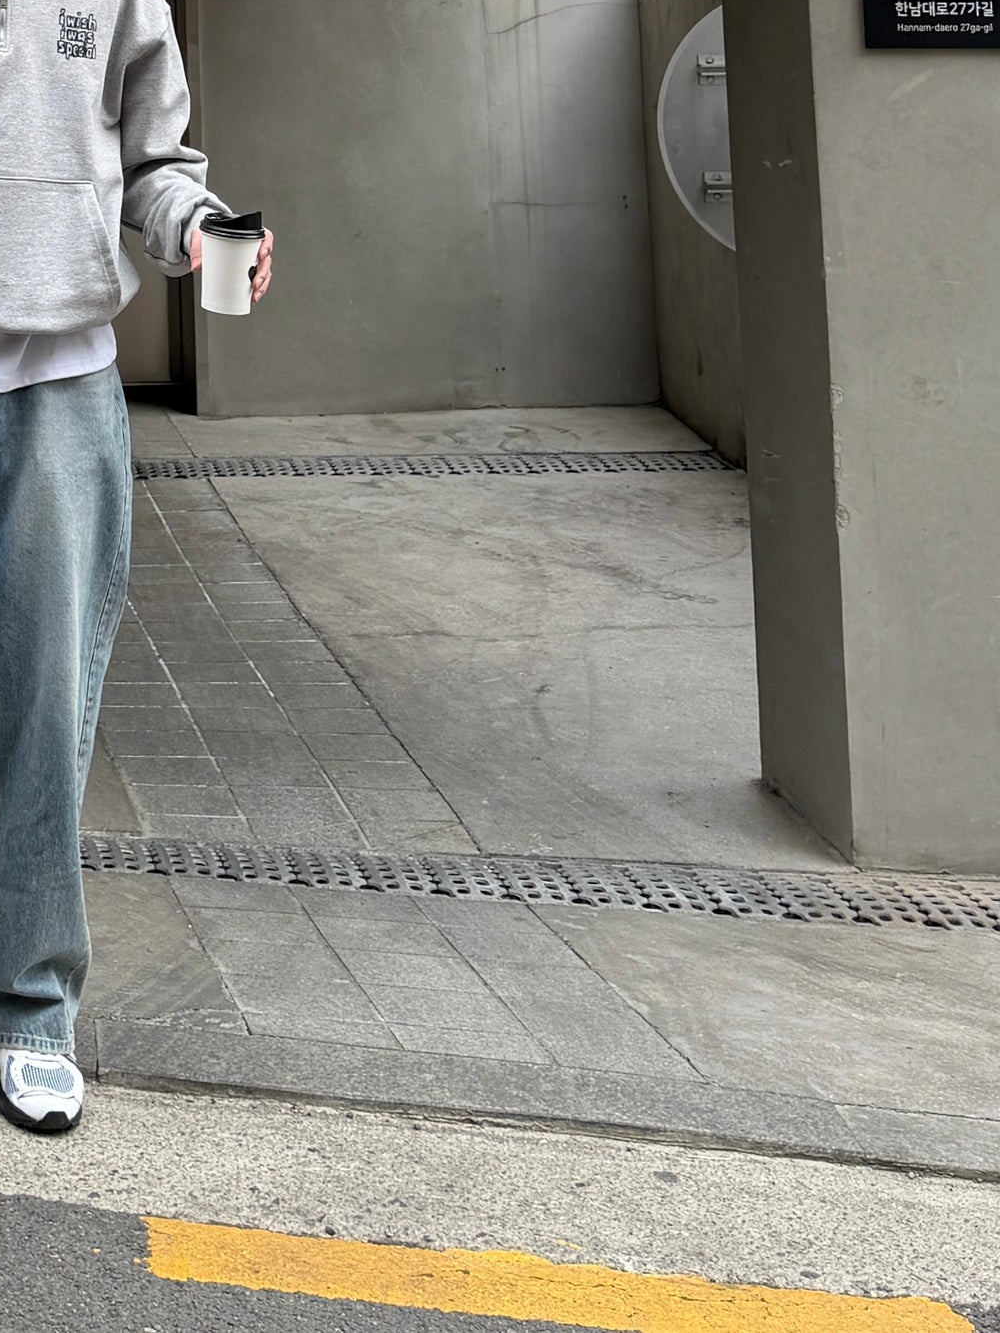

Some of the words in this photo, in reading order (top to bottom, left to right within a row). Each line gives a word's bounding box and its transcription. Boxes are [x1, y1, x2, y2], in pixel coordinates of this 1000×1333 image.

[895, 1, 995, 17] 한남대로27가길
[66, 11, 97, 32] wish
[897, 23, 958, 32] Hannam-daero
[959, 23, 993, 34] 27ga-gil
[66, 28, 95, 45] was
